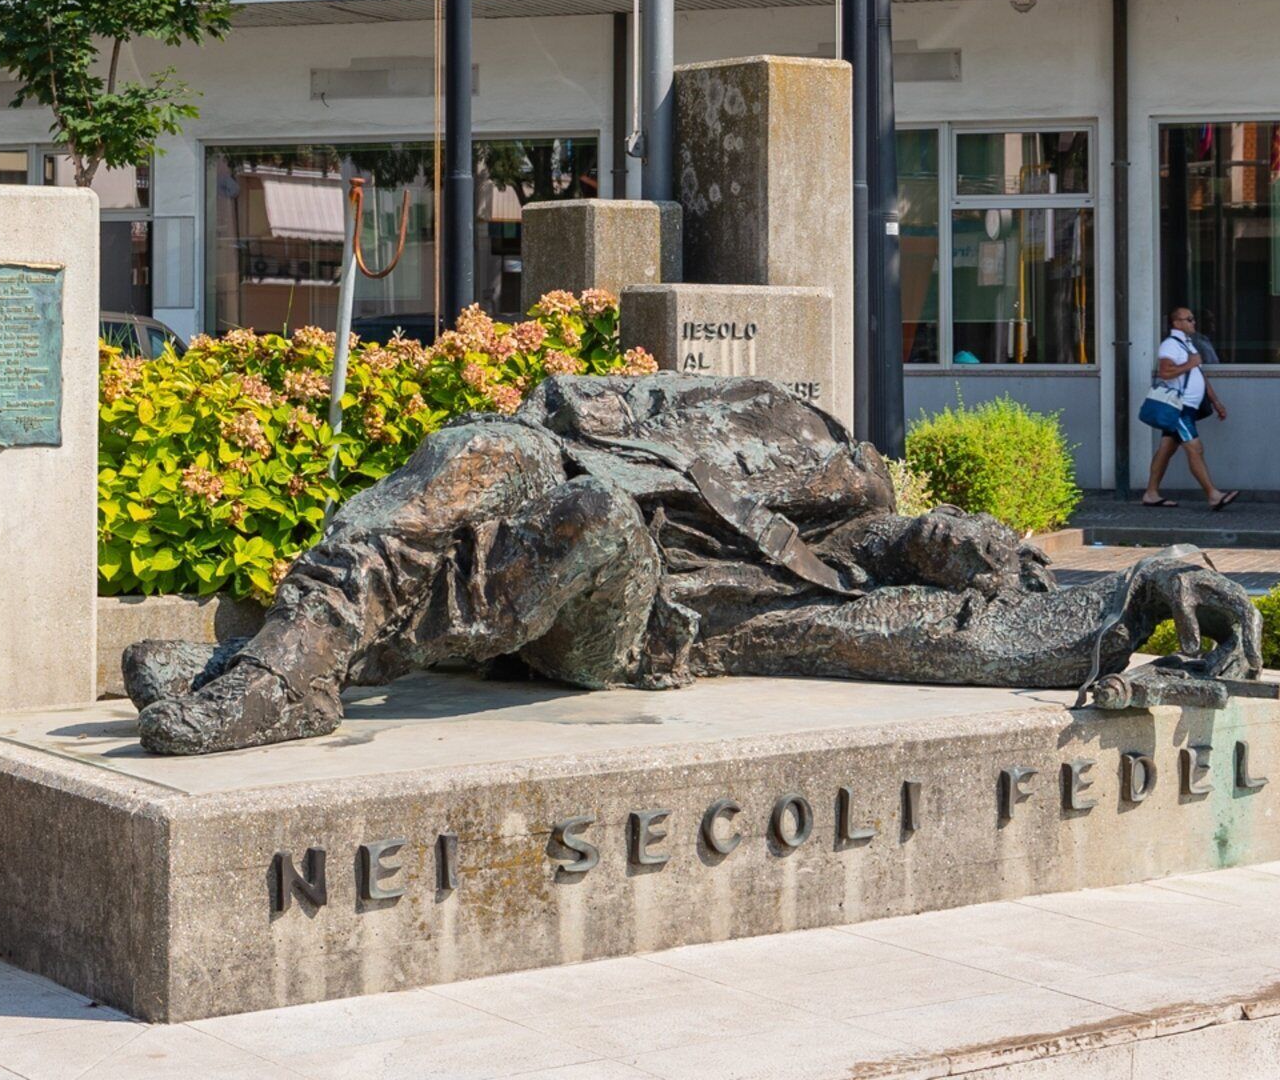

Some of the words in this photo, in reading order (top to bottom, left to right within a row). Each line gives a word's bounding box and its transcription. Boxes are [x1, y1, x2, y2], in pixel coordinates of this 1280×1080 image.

[682, 321, 757, 342] IESOLO
[683, 352, 710, 370] AL
[272, 833, 458, 912] NEI
[553, 780, 922, 873] SECOLI
